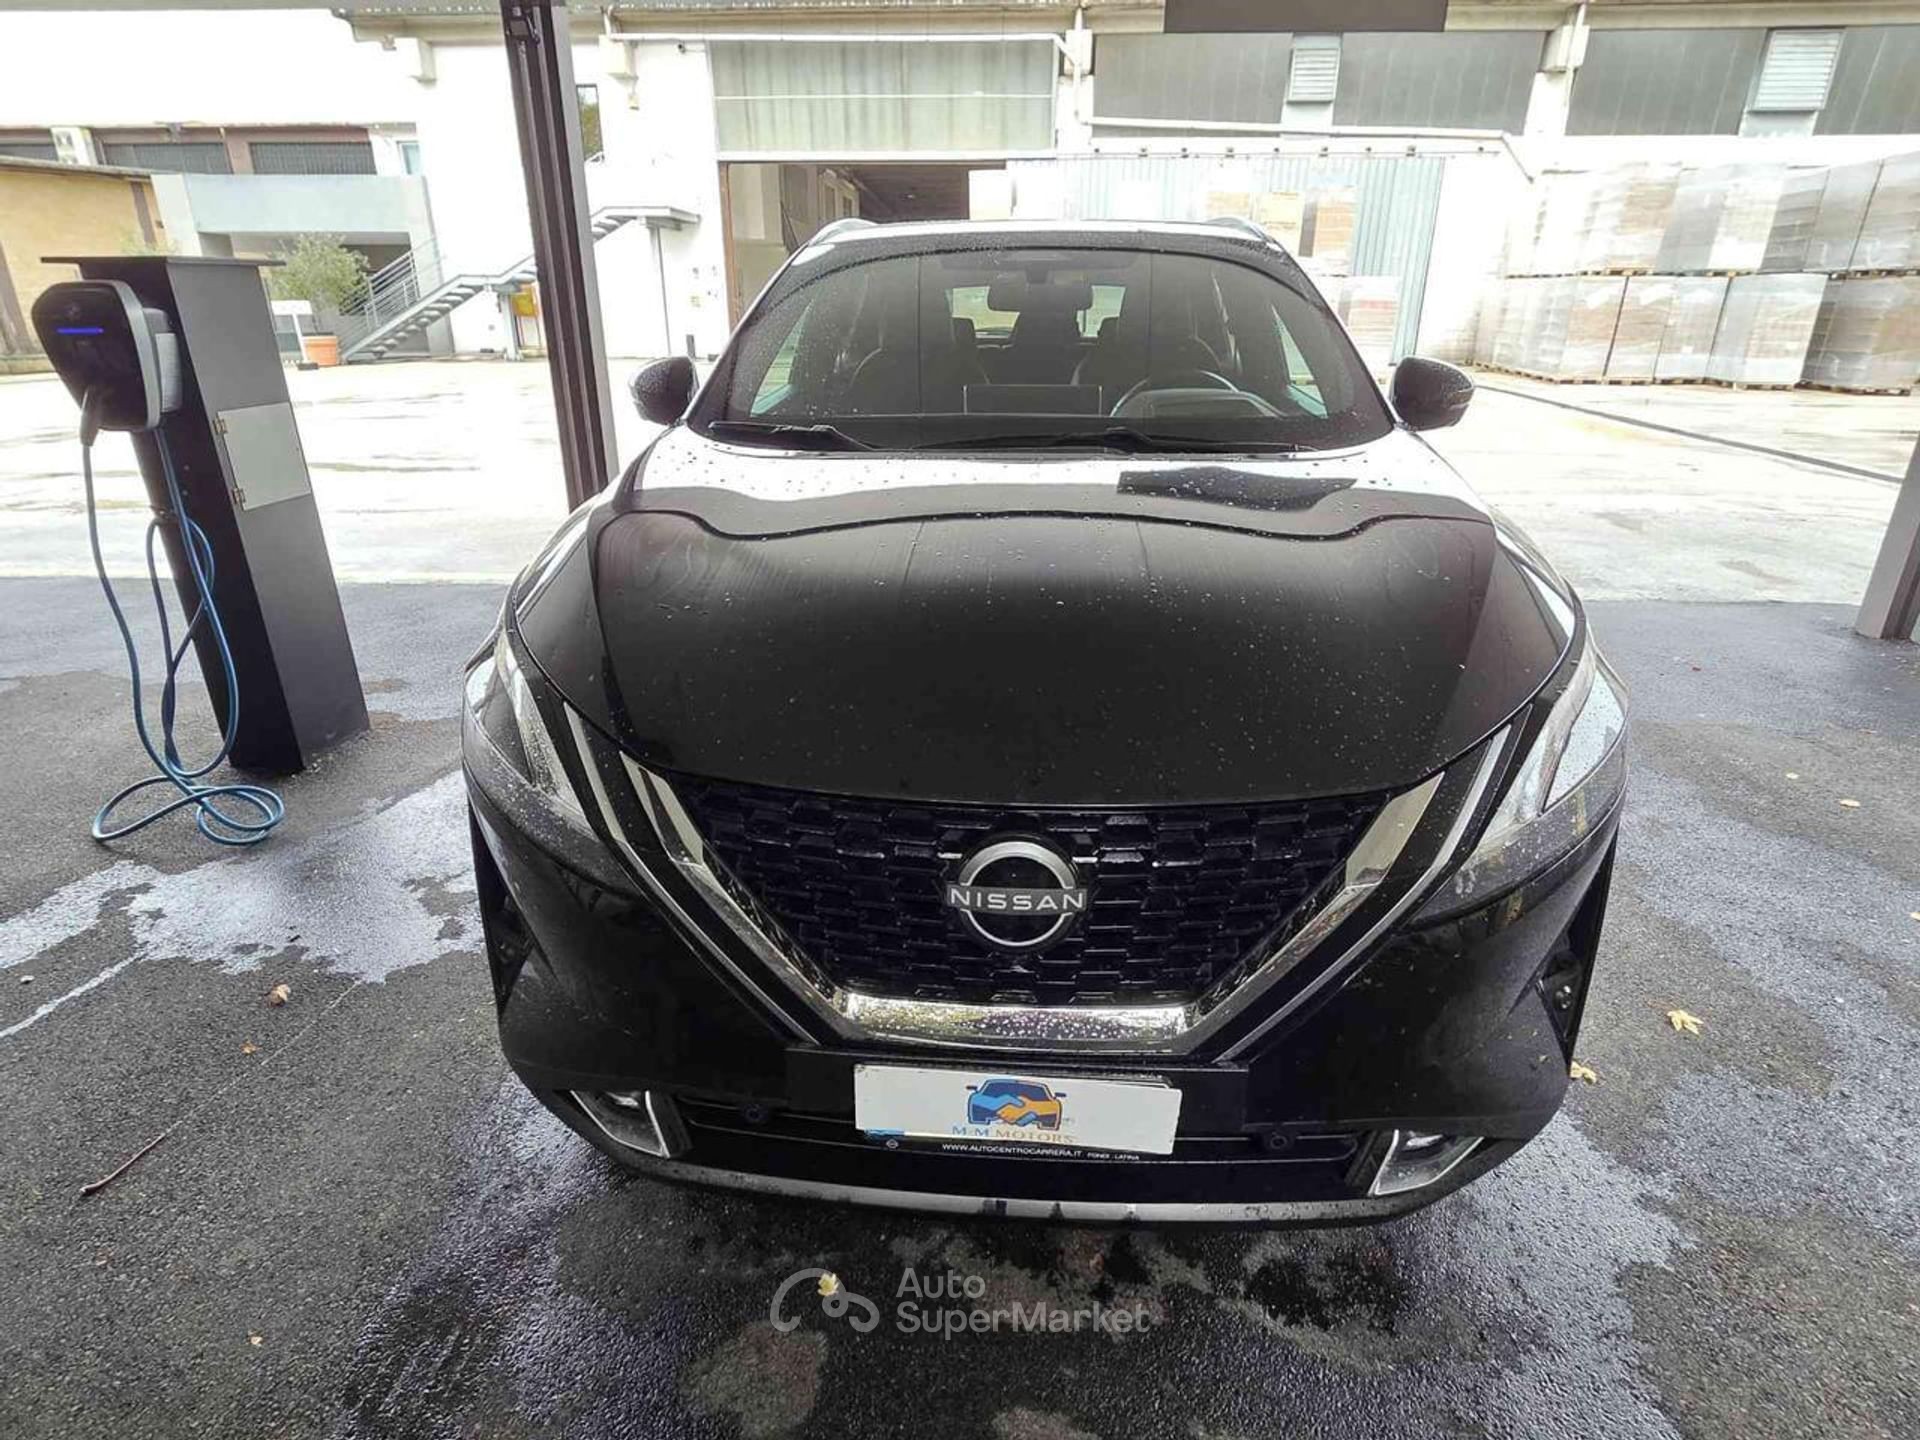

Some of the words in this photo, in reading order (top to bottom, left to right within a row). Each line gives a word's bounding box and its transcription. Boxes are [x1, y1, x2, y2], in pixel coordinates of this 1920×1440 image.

[950, 888, 1083, 911] NISSAN
[995, 1130, 1074, 1144] MOTORS
[942, 1143, 1081, 1158] WWW.AUTOCENTROCARRERA.IT
